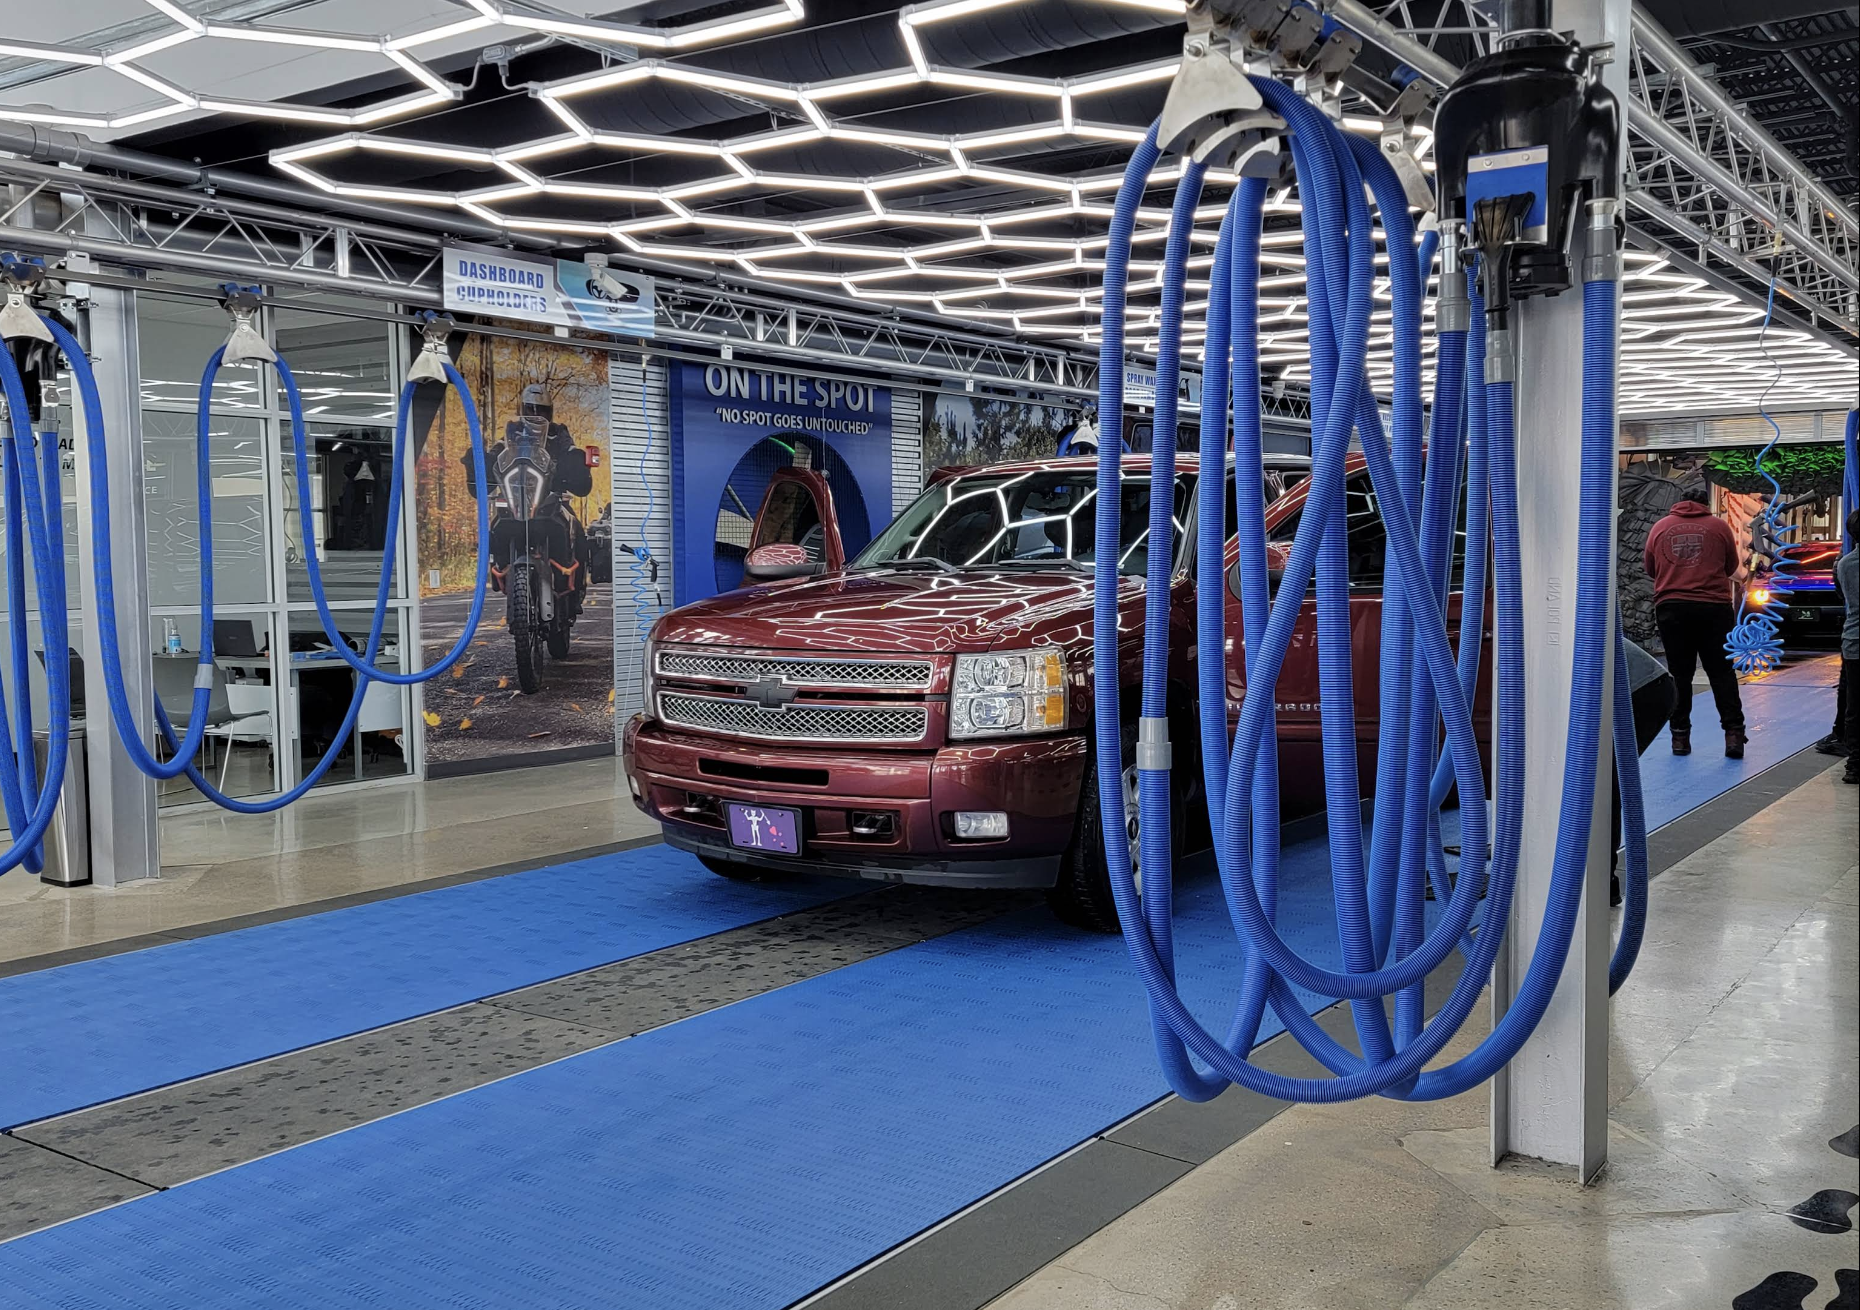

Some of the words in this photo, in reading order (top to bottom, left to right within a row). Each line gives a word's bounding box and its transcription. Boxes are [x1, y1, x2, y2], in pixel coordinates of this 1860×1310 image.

[459, 260, 544, 289] DASHBOARD
[456, 285, 547, 313] CUPHOLDERS
[705, 364, 750, 399] ON
[755, 370, 808, 406] THE
[814, 377, 878, 413] SPOT
[1126, 372, 1144, 385] SPRAY
[742, 410, 772, 426] SPOT
[773, 413, 803, 429] GOES
